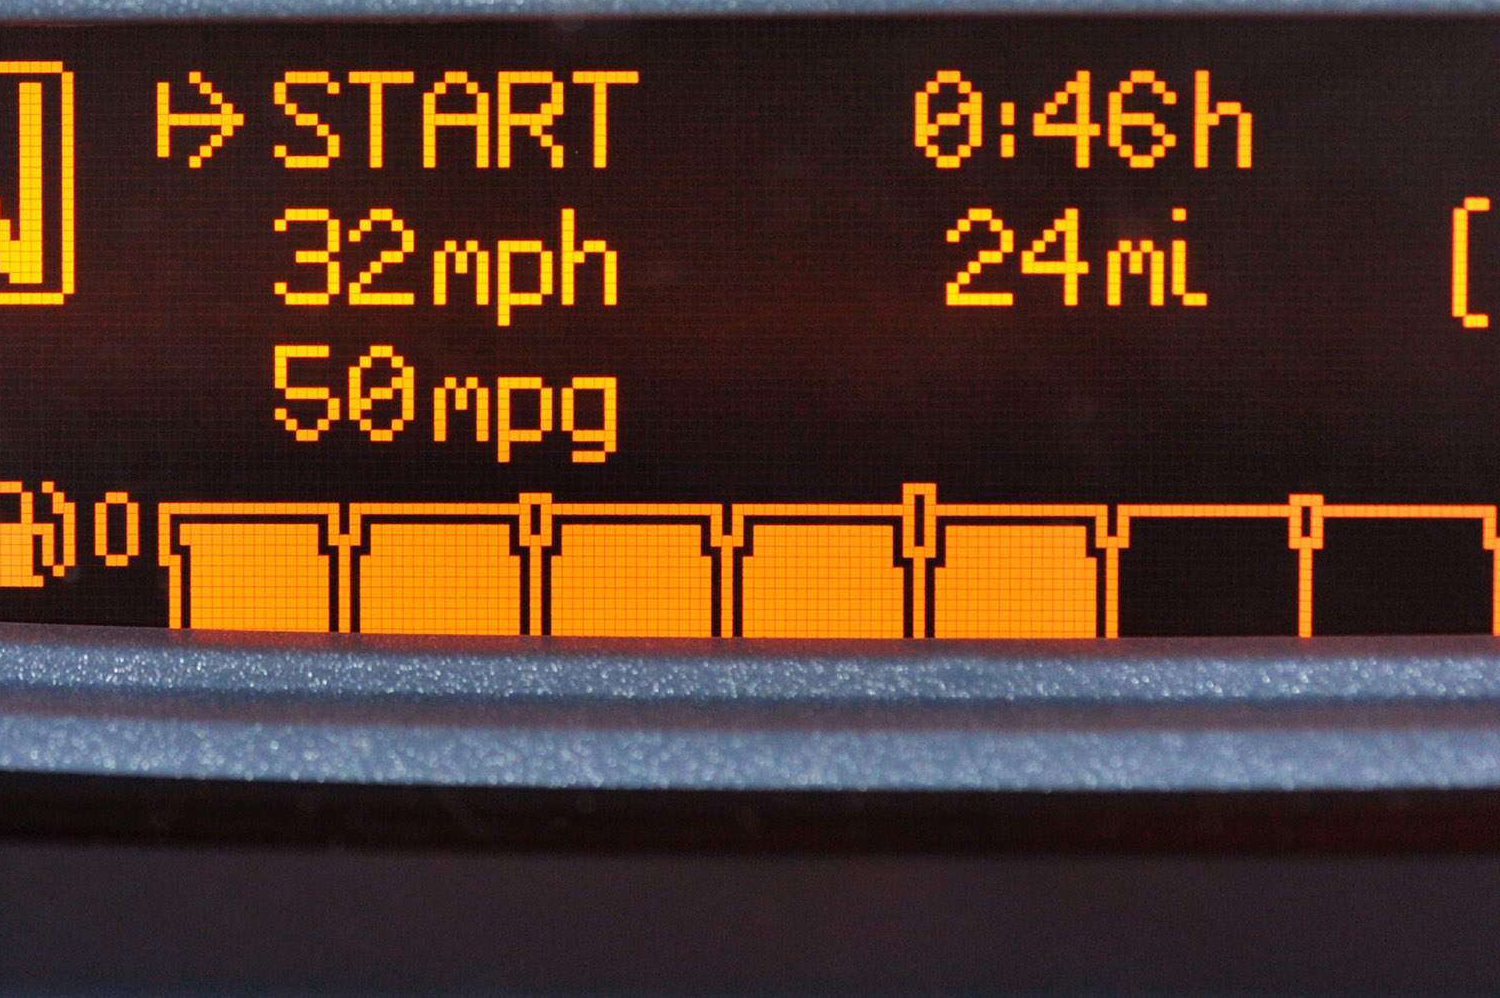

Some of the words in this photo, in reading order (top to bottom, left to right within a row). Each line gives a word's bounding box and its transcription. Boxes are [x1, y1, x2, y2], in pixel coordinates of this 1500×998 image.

[273, 70, 639, 169] START
[914, 69, 1253, 169] 0:46h
[273, 207, 617, 327] 32mph
[945, 207, 1208, 306] 24mi
[273, 344, 617, 463] 50mpg
[94, 491, 139, 567] 0
